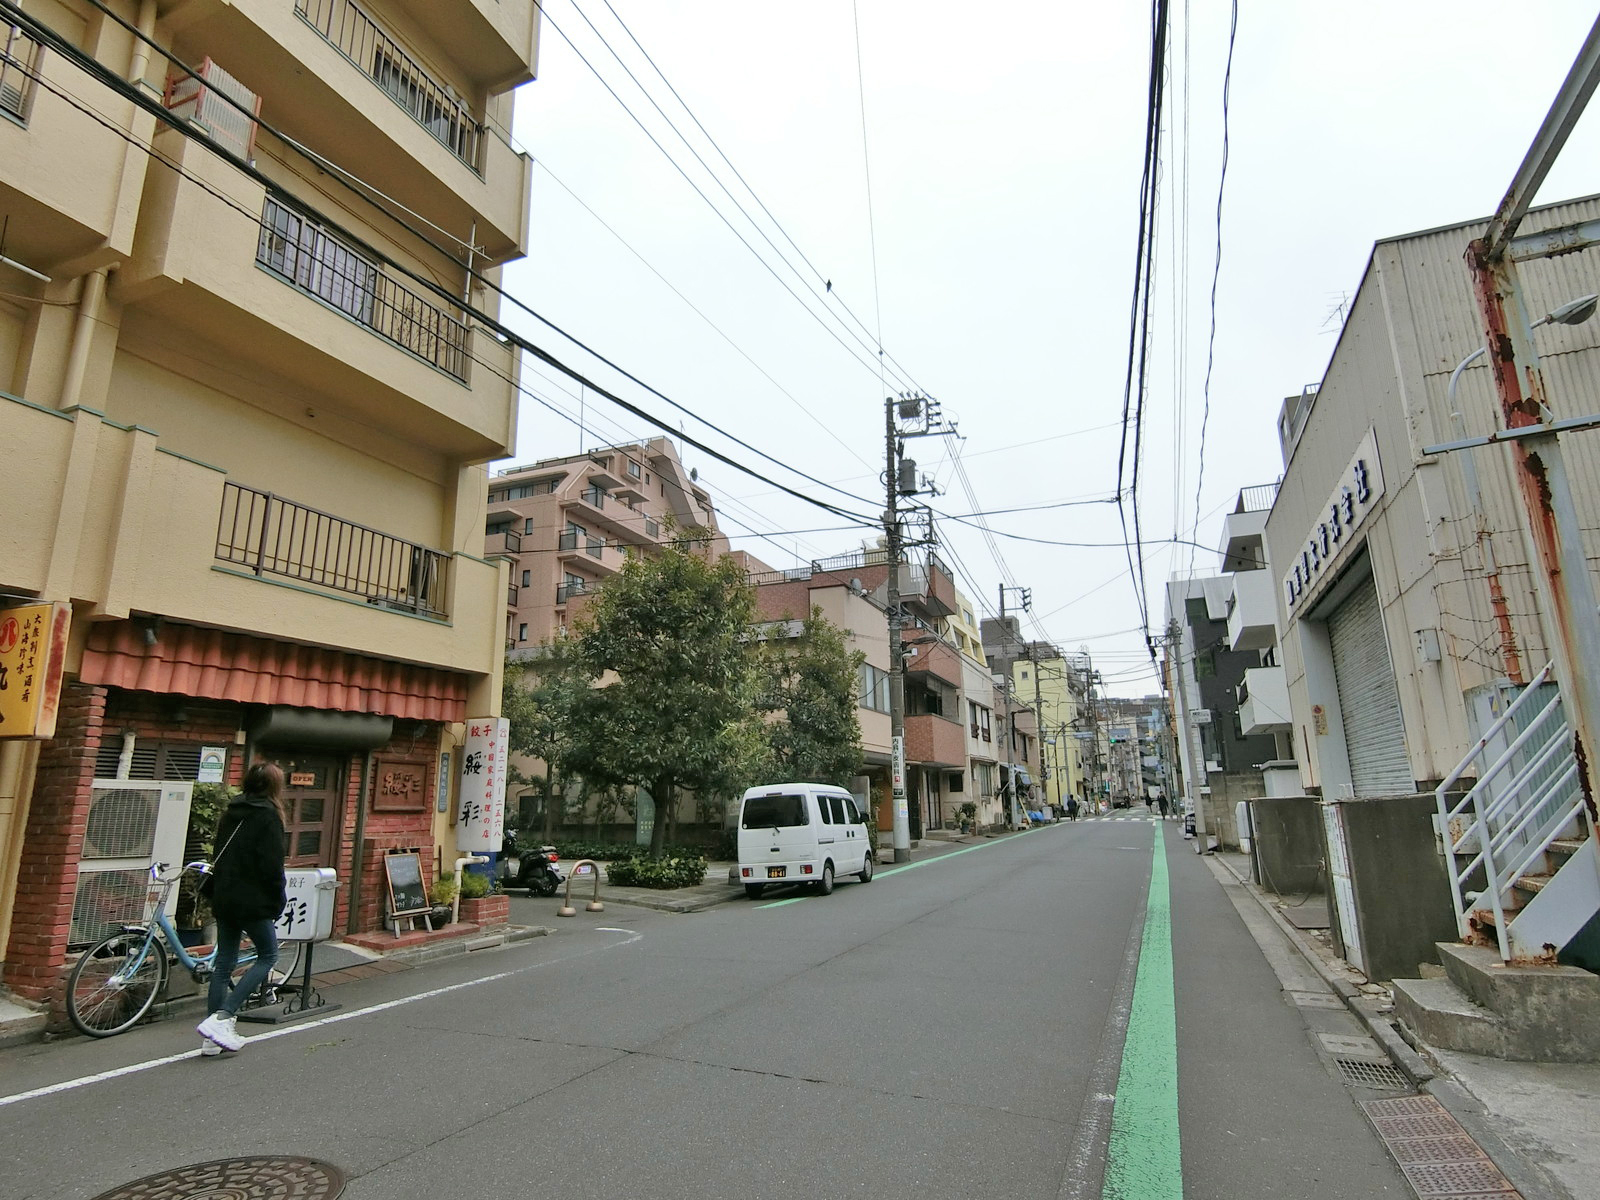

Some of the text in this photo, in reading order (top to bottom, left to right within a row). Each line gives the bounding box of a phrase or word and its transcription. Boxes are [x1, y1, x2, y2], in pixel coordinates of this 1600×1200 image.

[16, 618, 32, 676] 山海珍味
[471, 724, 492, 738] 餃子
[288, 876, 306, 889] 餃子
